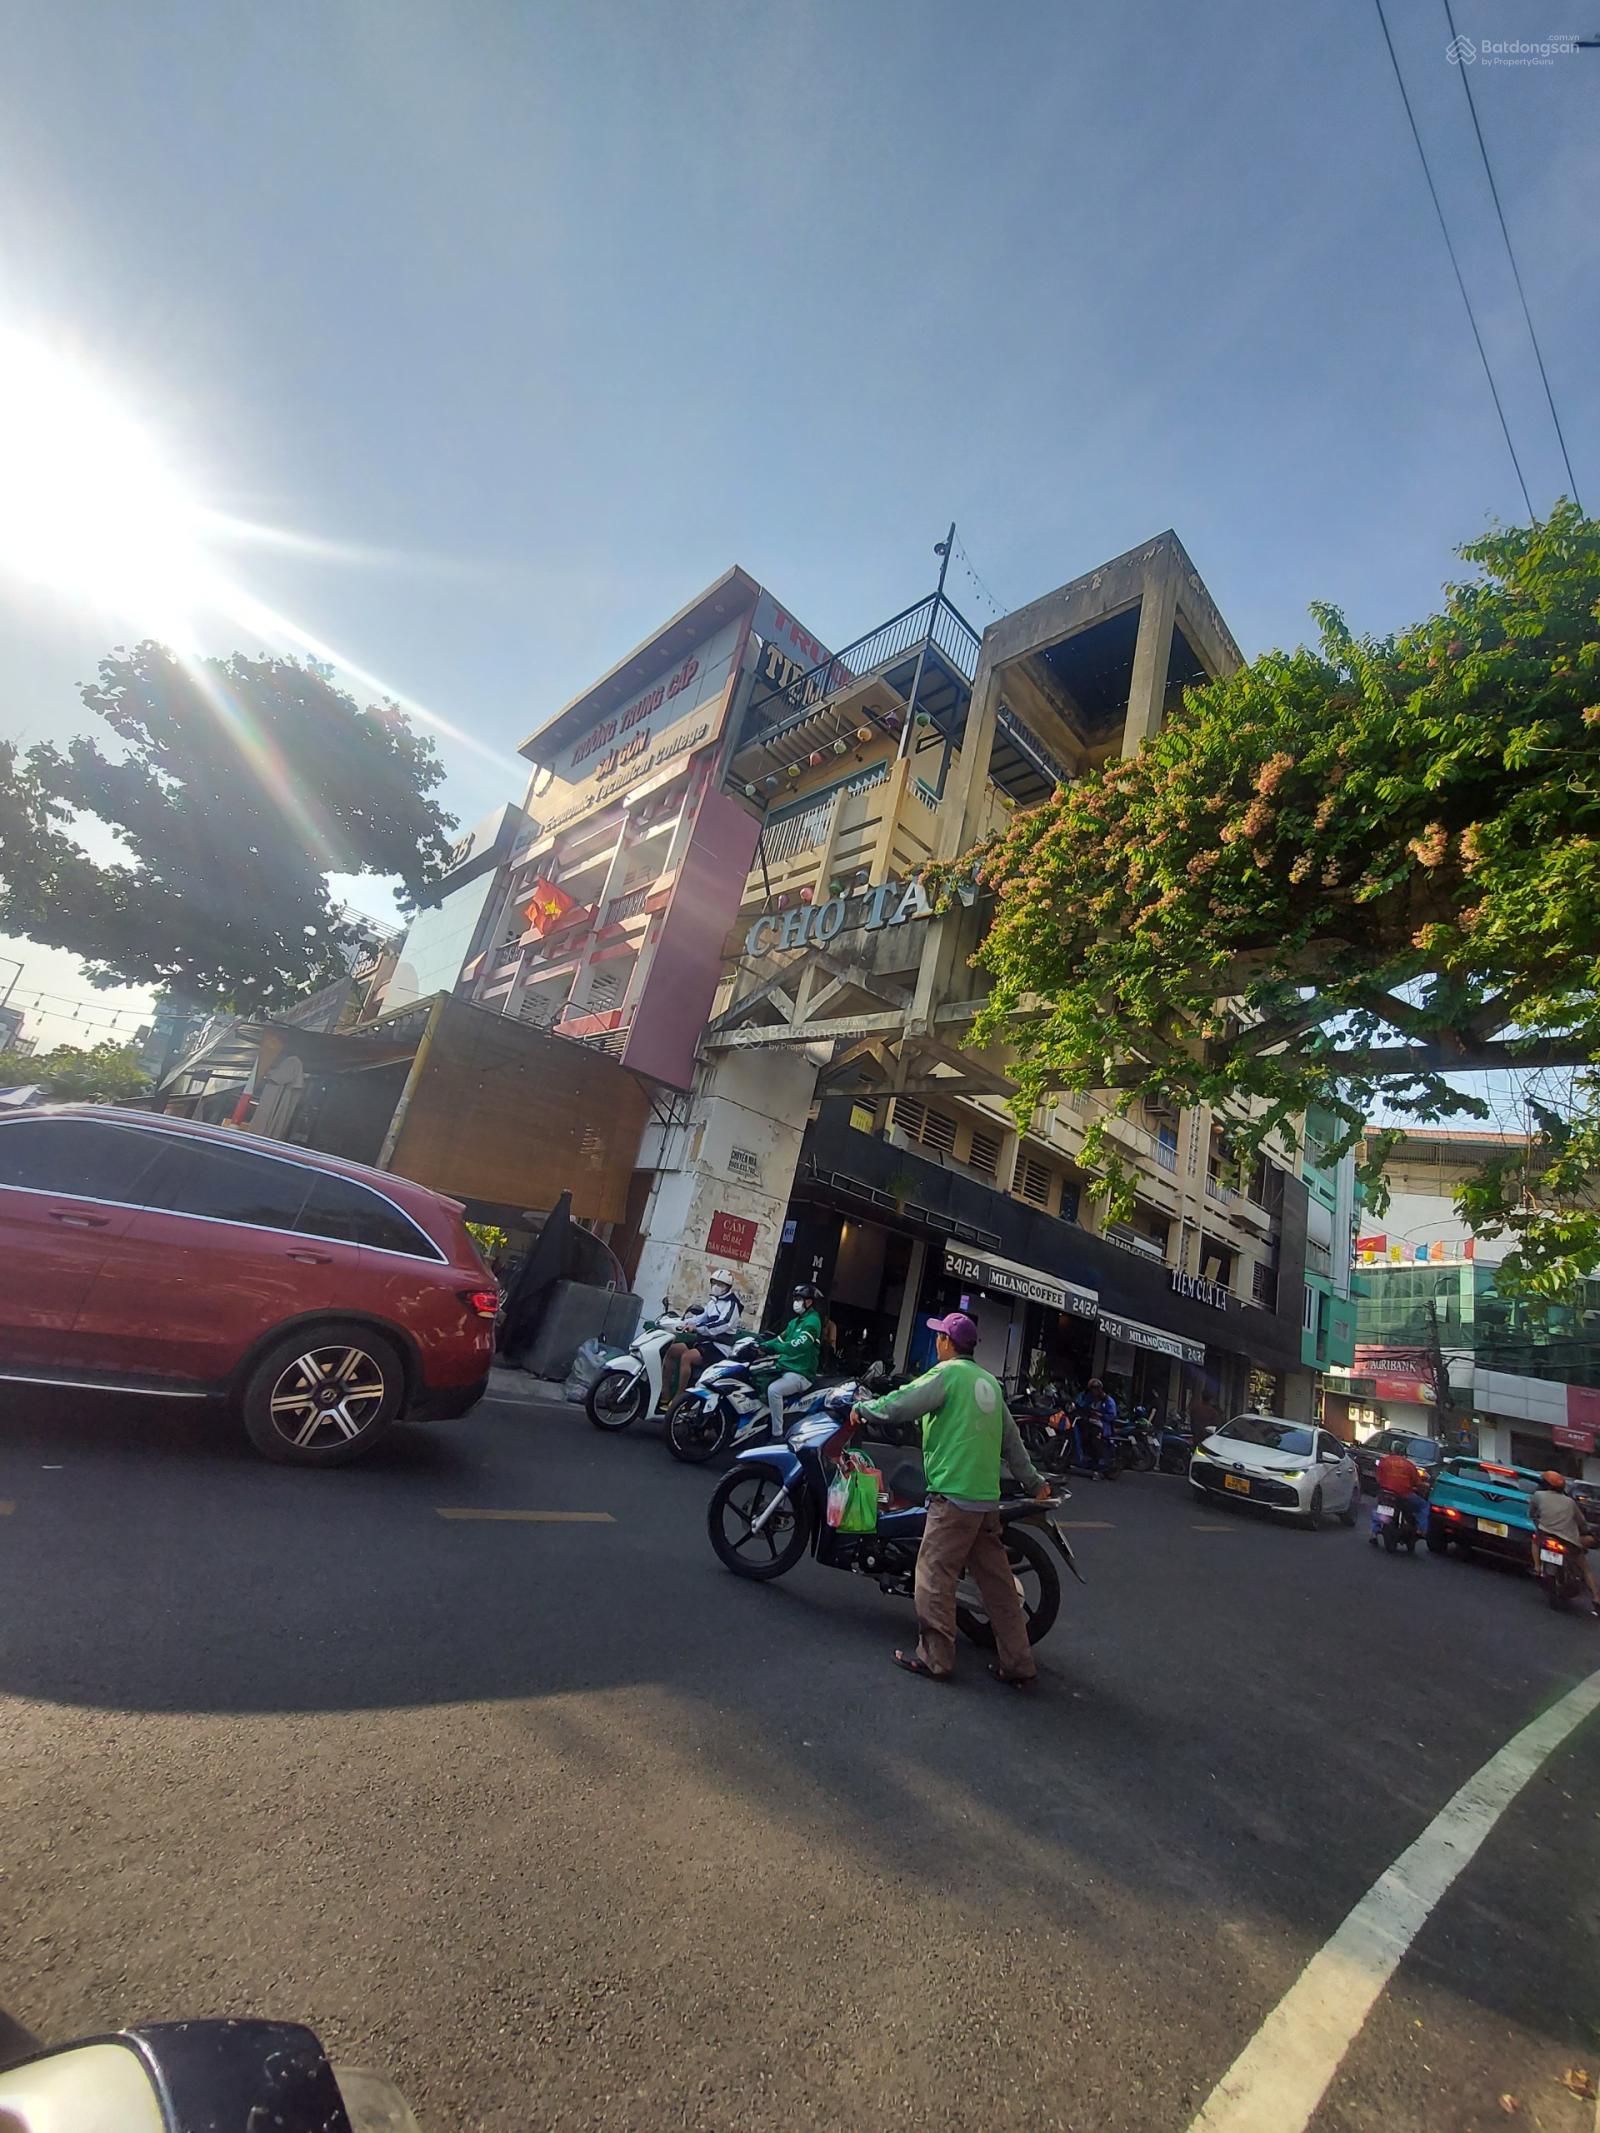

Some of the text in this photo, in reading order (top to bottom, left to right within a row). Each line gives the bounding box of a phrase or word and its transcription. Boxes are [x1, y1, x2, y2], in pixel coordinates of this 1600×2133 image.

[723, 1218, 746, 1235] CẤM
[945, 1255, 1098, 1317] 24/24 MILANO COFFEE 24/24
[1099, 1318, 1122, 1338] 24/24
[1129, 1330, 1158, 1348] MILANO
